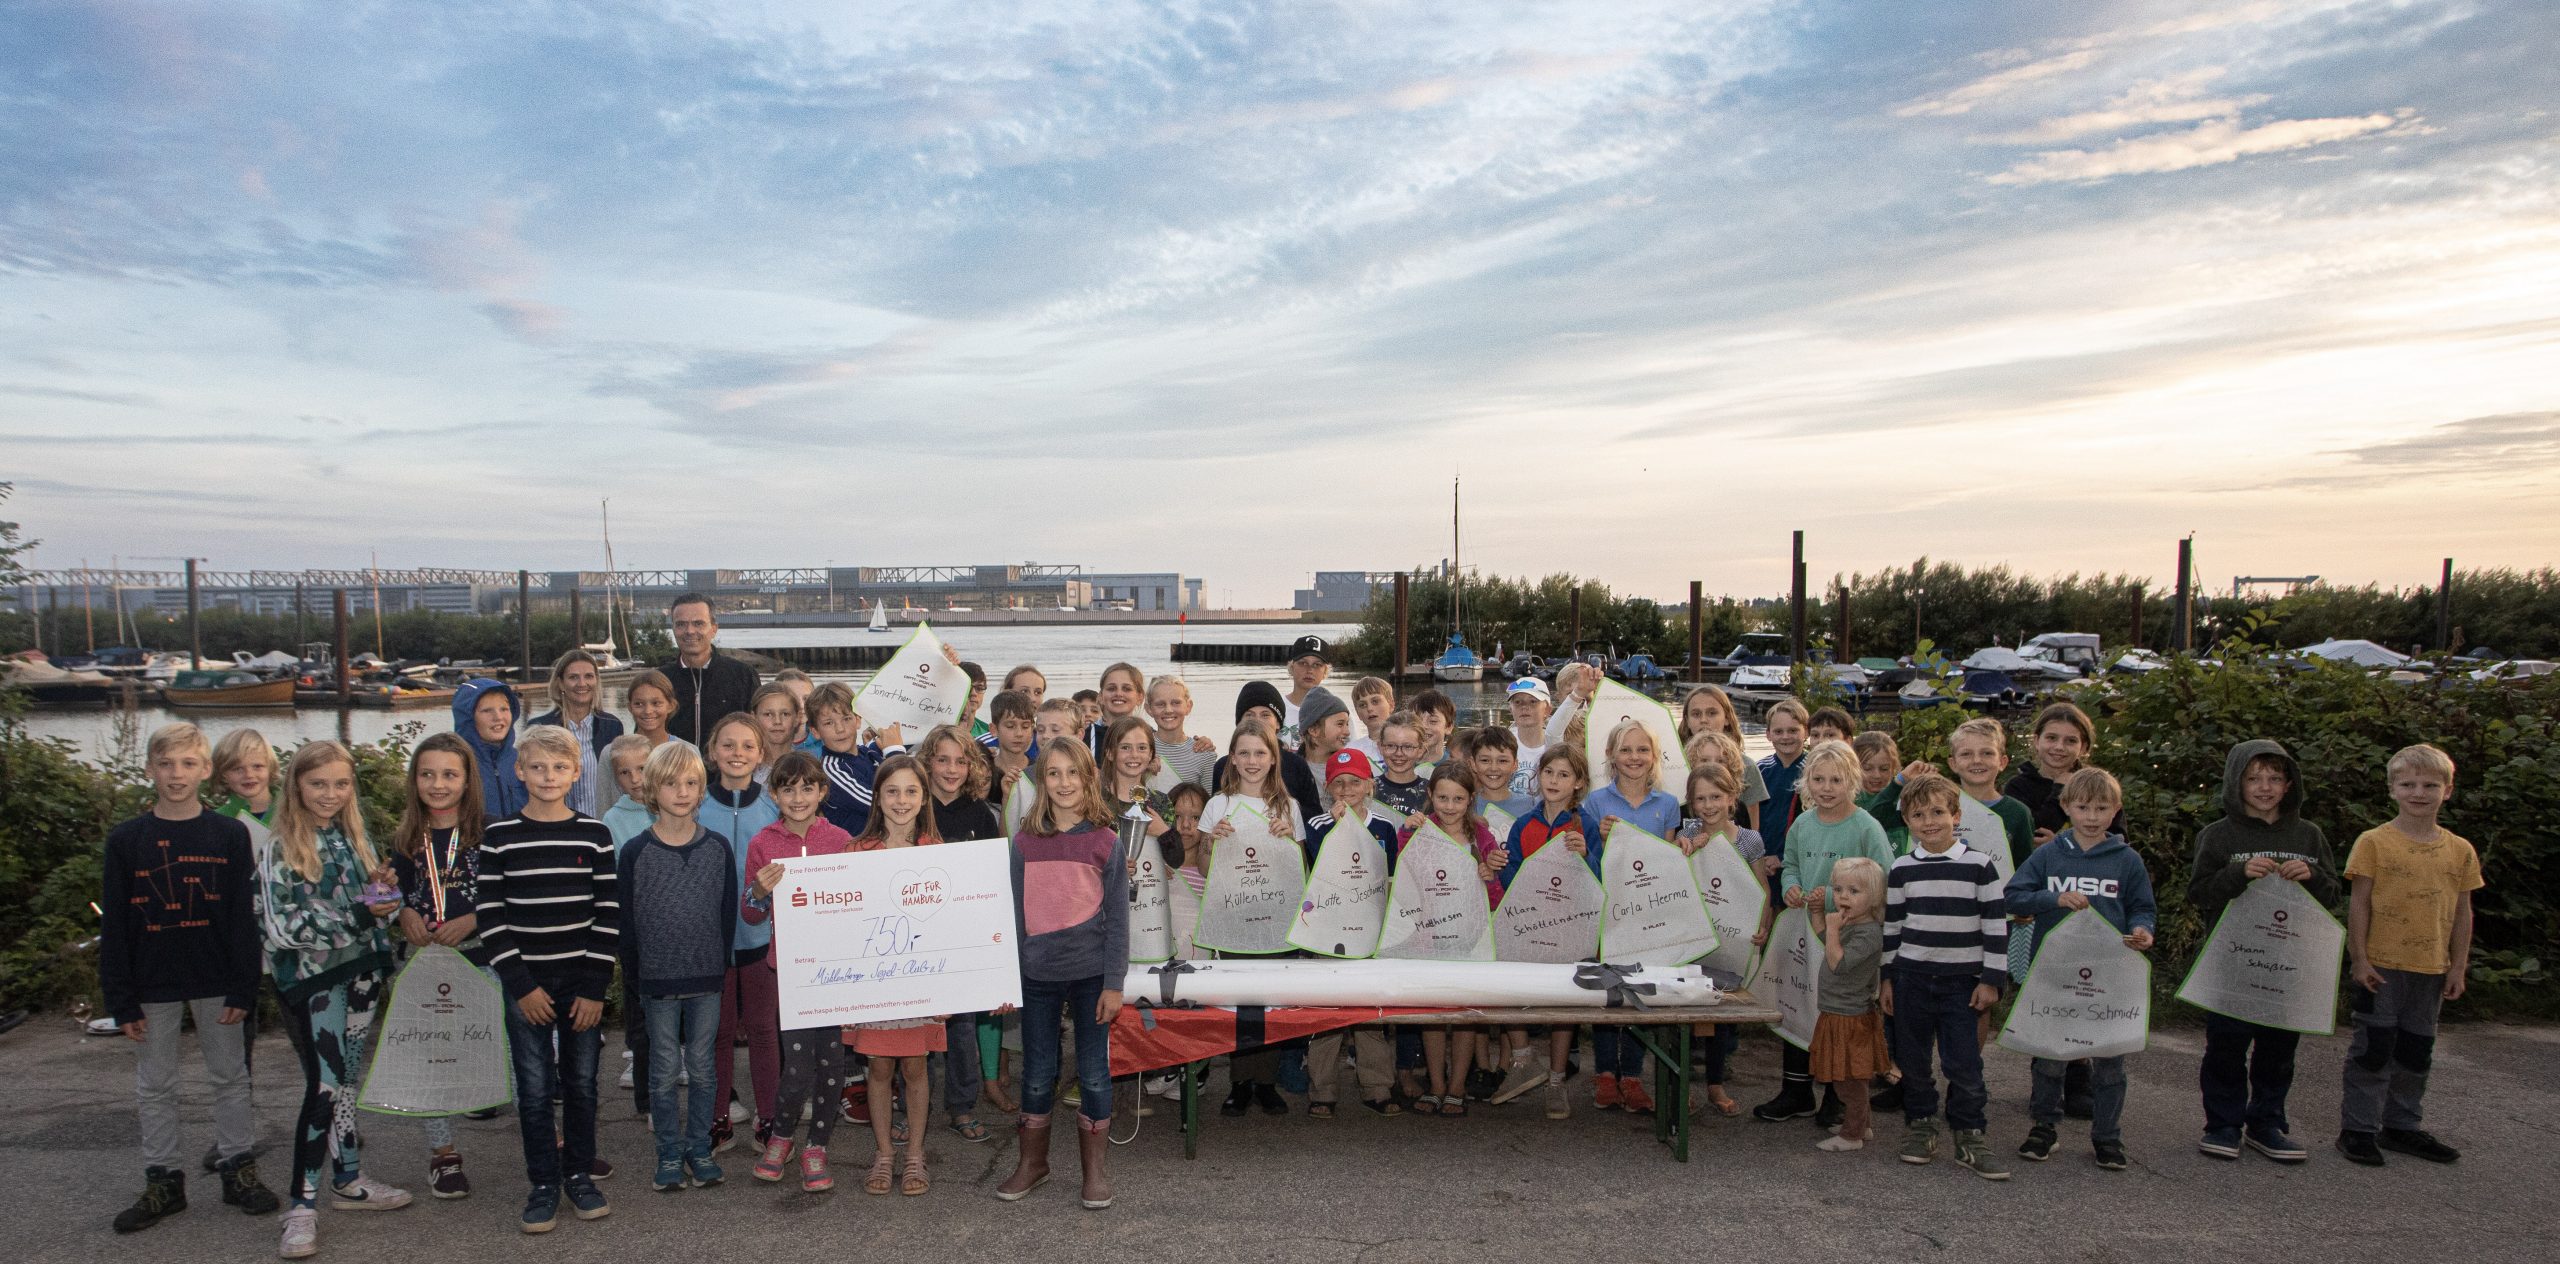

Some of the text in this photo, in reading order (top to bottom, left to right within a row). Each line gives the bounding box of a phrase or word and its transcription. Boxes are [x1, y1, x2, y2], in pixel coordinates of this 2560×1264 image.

[177, 856, 228, 864] GENERATION
[2231, 852, 2251, 860] LIVE
[804, 866, 836, 874] Förderung
[902, 880, 941, 896] GUT FÜR
[2047, 876, 2118, 898] MSC
[814, 891, 863, 906] Haspa
[902, 894, 943, 906] HAMBURG
[1317, 893, 1342, 909] Lotte
[1613, 889, 1689, 920] Carla Heerma
[1400, 908, 1423, 918] Enna
[1505, 906, 1537, 918] Klara
[180, 919, 210, 927] CHANGE
[992, 932, 1002, 943] €
[2228, 942, 2265, 955] Johann
[1764, 972, 1783, 984] Frida
[2031, 1000, 2140, 1020] Lasse Schmidt
[388, 1024, 492, 1045] Katharina Koch
